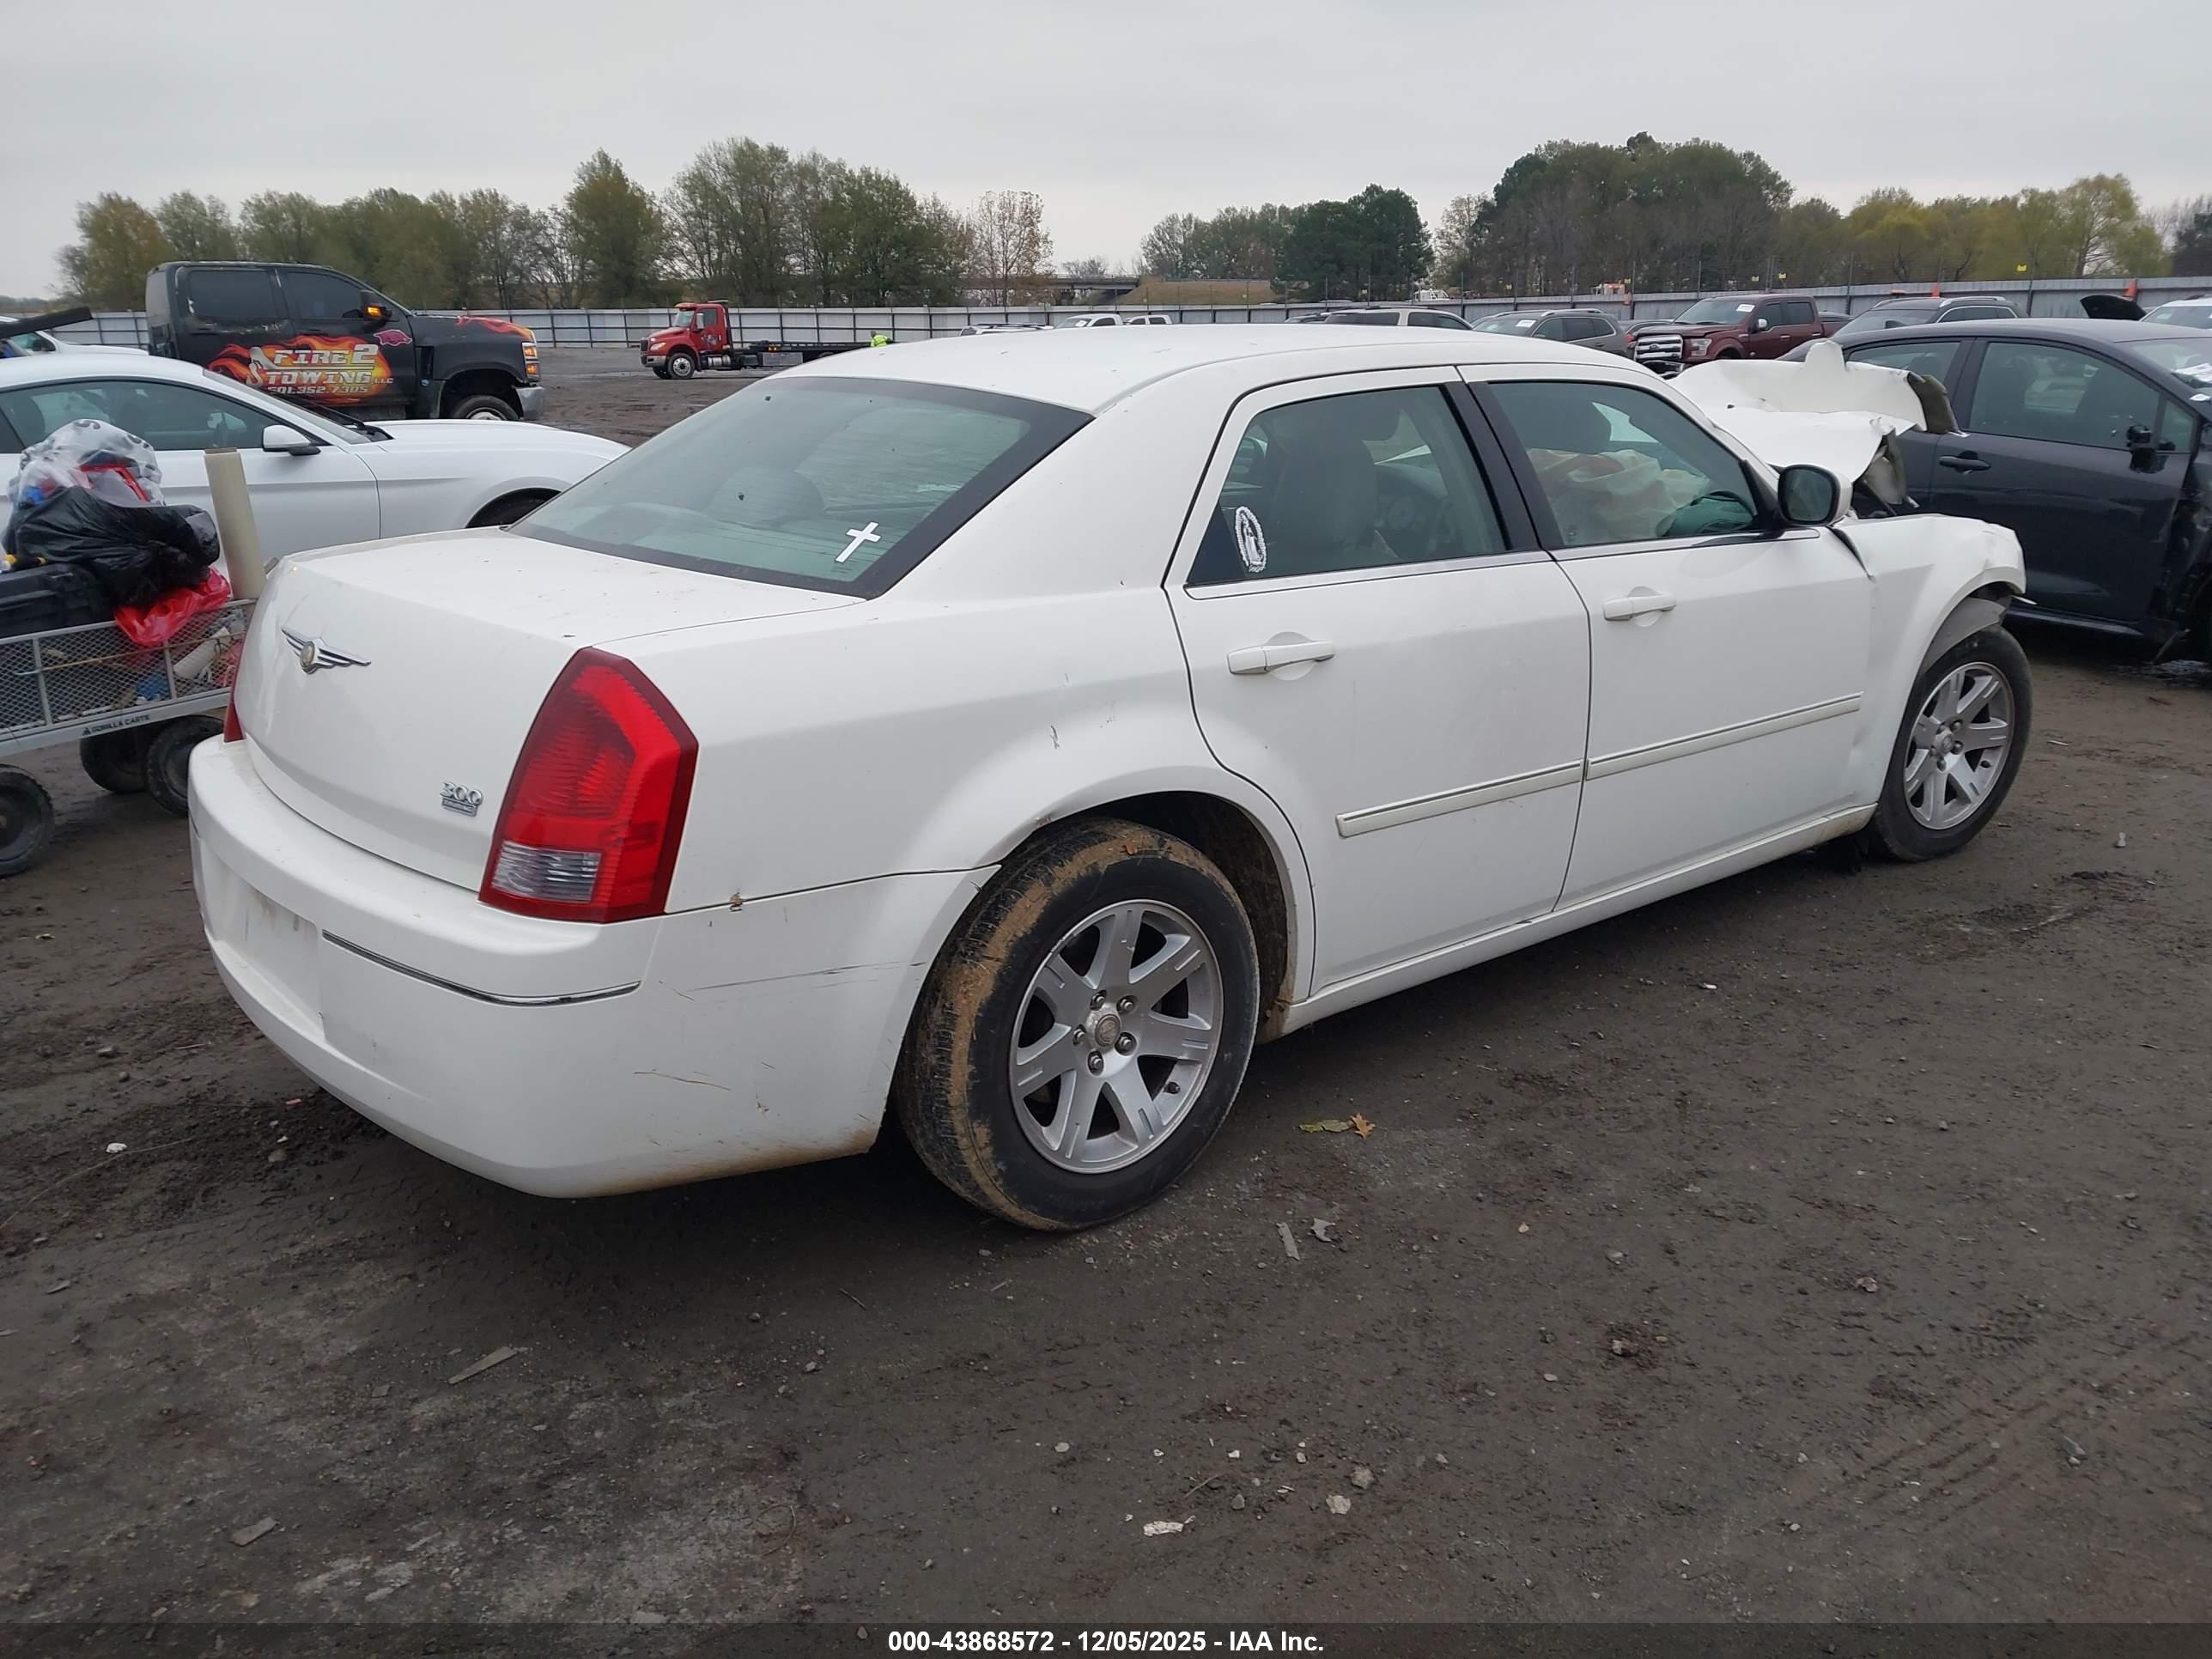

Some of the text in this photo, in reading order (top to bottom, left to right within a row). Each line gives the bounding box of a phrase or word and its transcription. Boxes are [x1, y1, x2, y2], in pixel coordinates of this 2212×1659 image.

[274, 343, 379, 364] FIRE 2
[91, 714, 150, 733] GORILLA CARTS
[439, 781, 484, 805] 300
